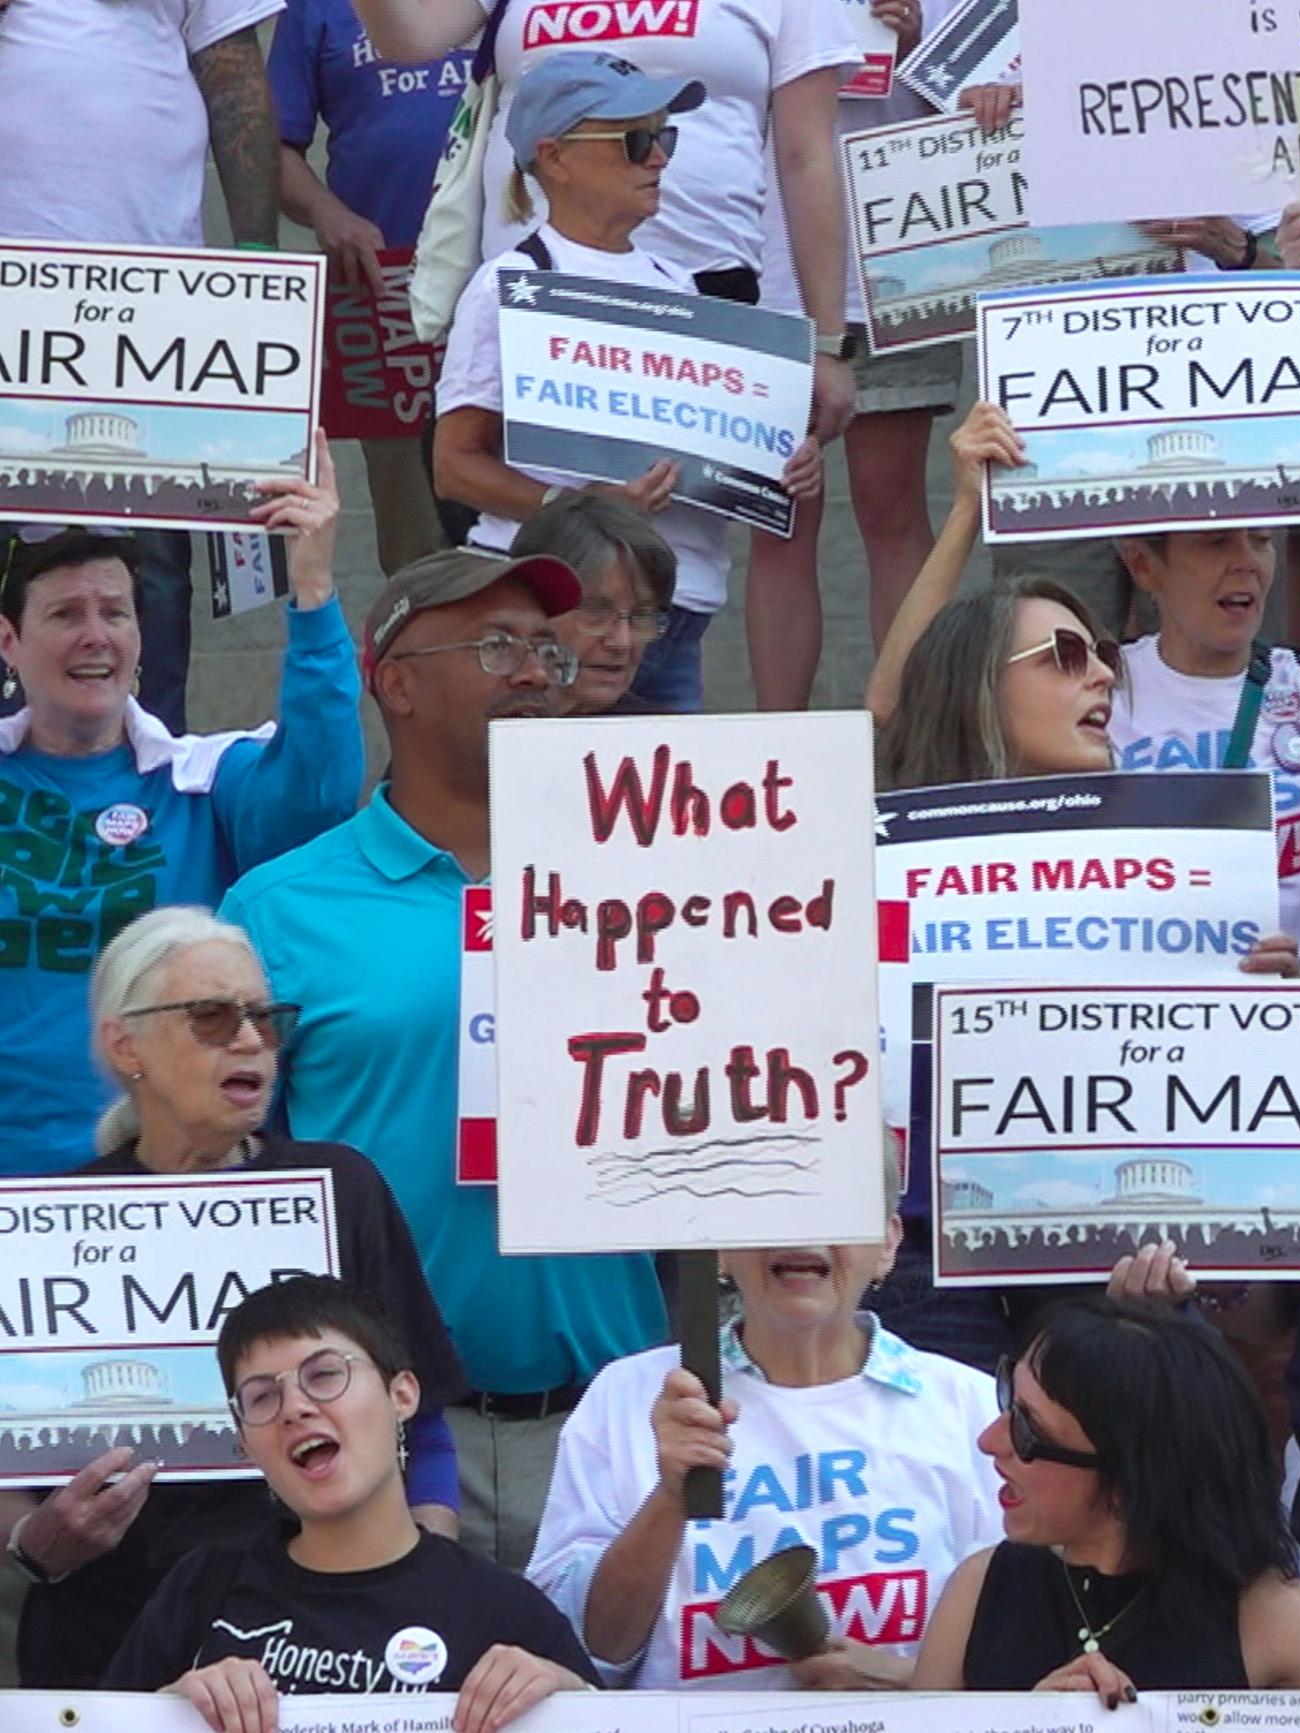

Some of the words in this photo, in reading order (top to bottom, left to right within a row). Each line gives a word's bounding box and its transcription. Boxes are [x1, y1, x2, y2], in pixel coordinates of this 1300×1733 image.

[526, 1, 696, 44] NOW!
[1250, 0, 1277, 33] is
[378, 68, 429, 96] For
[976, 150, 1003, 173] for
[863, 178, 997, 245] FAIR
[0, 260, 169, 295] DISTRICT
[178, 269, 308, 302] VOTER
[74, 298, 113, 324] for
[117, 306, 135, 324] a
[1002, 308, 1054, 341] 7TH
[1063, 302, 1227, 335] DISTRICT
[0, 329, 88, 386] IR
[115, 333, 301, 396] MAP
[549, 336, 633, 374] FAIR
[641, 350, 746, 396] MAPS
[1145, 334, 1182, 357] for
[1187, 336, 1204, 353] a
[998, 363, 1164, 417] FAIR
[515, 373, 599, 412] FAIR
[607, 388, 796, 459] ELECTIONS
[584, 743, 797, 848] What
[906, 794, 1103, 820] commoncause.org/ohio
[905, 861, 1018, 898] FAIR
[1031, 857, 1176, 892] MAPS
[521, 863, 835, 971] Happened
[986, 916, 1261, 956] ELECTIONS
[642, 967, 701, 1033] to
[949, 1000, 1028, 1035] 15TH
[1038, 1003, 1219, 1032] DISTRICT
[1119, 1039, 1162, 1067] for
[1166, 1043, 1185, 1063] a
[567, 1031, 869, 1147] Truth?
[951, 1074, 1137, 1137] FAIR
[178, 1196, 320, 1228] VOTER
[73, 1239, 113, 1267] for
[119, 1244, 137, 1264] a
[0, 1276, 98, 1337] IR
[122, 1267, 309, 1334] MA
[723, 1449, 869, 1522] AIR
[689, 1578, 918, 1671] NW!
[261, 1636, 385, 1694] Honesty
[1177, 1694, 1215, 1706] party
[1217, 1693, 1286, 1706] primaries
[1223, 1711, 1262, 1725] allow
[342, 1719, 380, 1733] Mark
[383, 1718, 400, 1732] of
